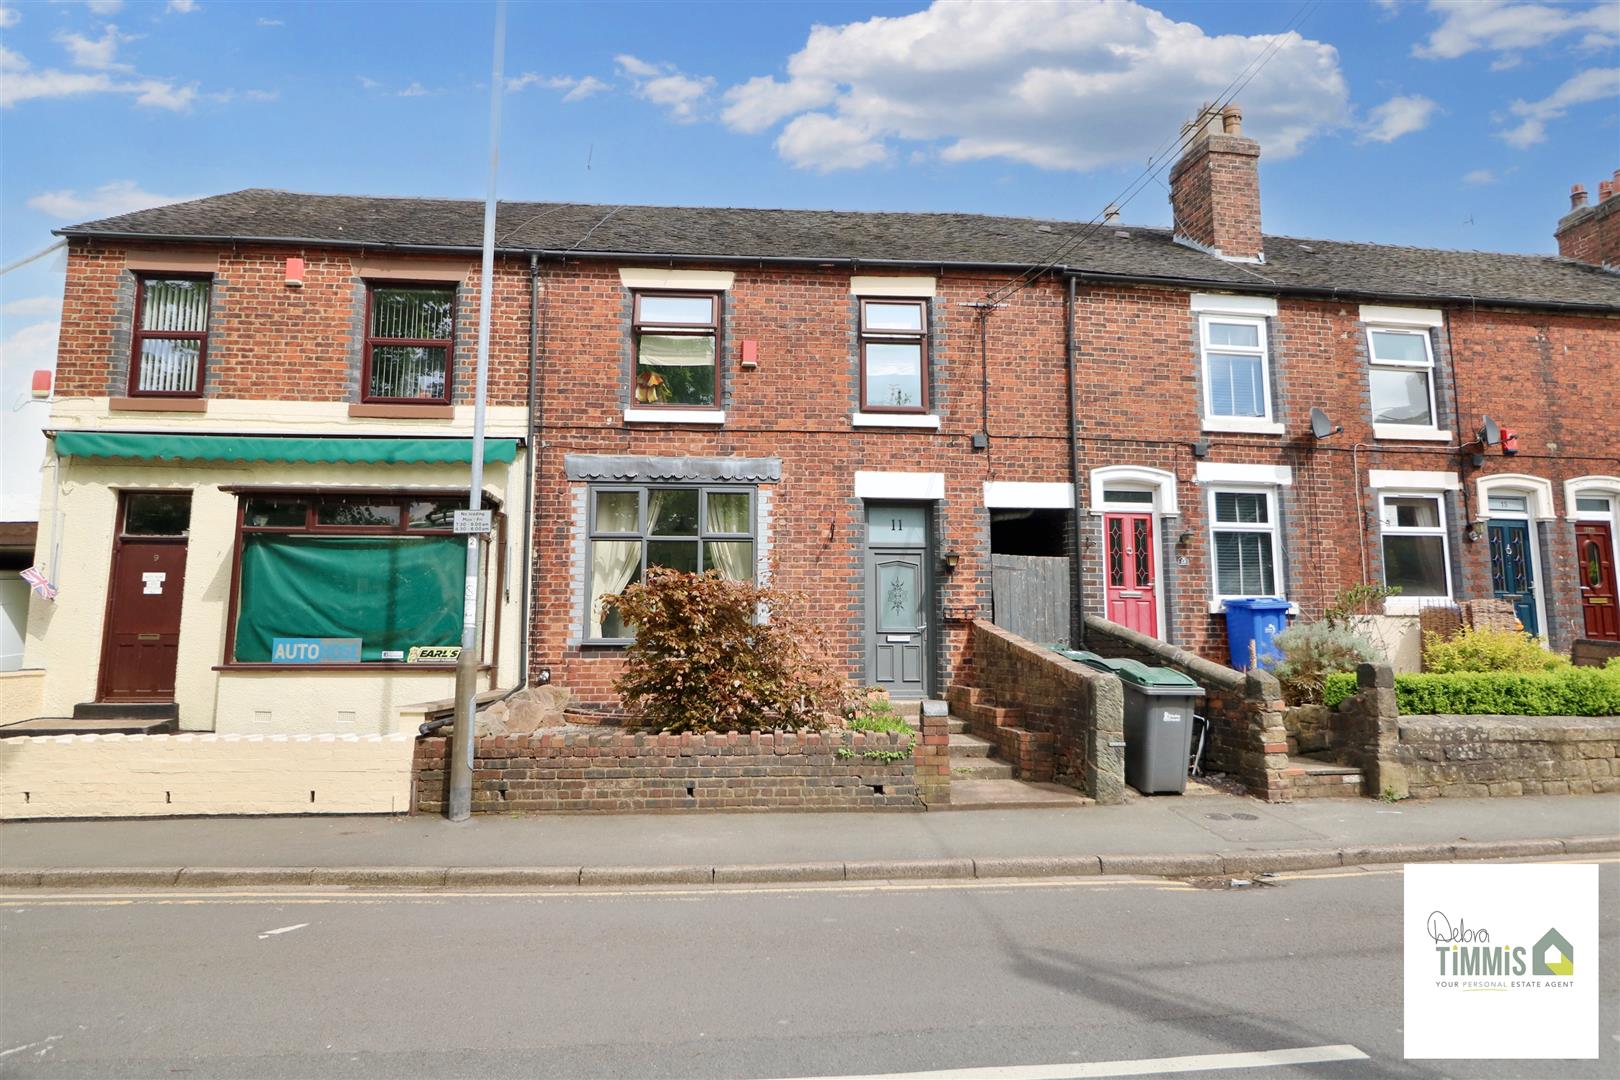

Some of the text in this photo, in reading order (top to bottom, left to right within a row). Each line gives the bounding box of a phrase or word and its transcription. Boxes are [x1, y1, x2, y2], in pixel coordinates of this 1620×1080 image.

[891, 519, 903, 531] 11
[274, 643, 320, 660] AUTO
[419, 649, 458, 658] EARL'S
